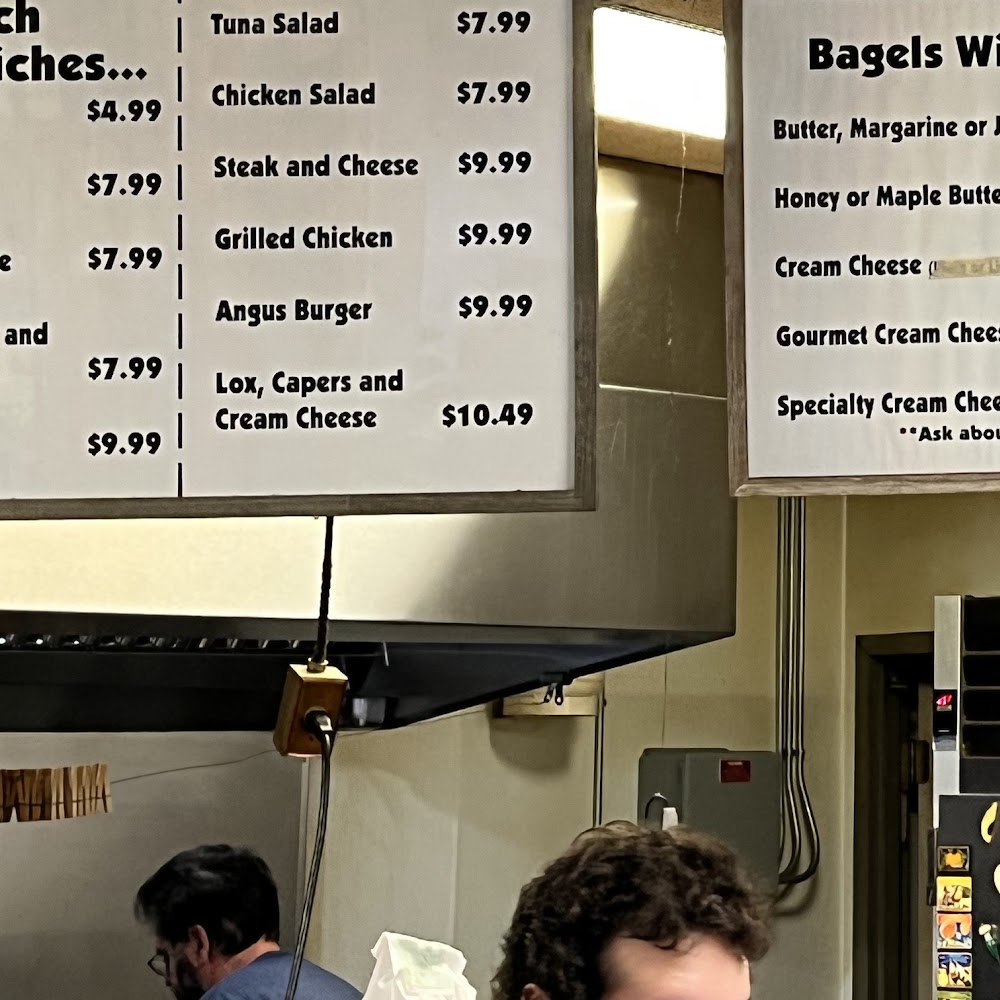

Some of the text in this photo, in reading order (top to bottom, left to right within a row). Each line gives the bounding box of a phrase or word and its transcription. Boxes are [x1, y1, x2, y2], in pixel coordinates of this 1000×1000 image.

[210, 11, 531, 35] Tuna Salad $7.99
[809, 35, 943, 78] Bagels
[212, 81, 531, 107] Chicken Salad $7.99
[87, 99, 162, 122] $4.99
[773, 119, 843, 144] Butter,
[850, 115, 958, 143] Margarine
[965, 120, 988, 137] or
[214, 151, 532, 178] Steak and Cheese $9.99
[87, 172, 162, 196] $7.99
[775, 187, 840, 212] Honey
[846, 190, 870, 207] or
[876, 184, 942, 211] Maple
[215, 222, 532, 250] Grilled Chicken $9.99
[88, 247, 162, 270] $7.99
[775, 256, 841, 278] Cream
[849, 254, 922, 276] Cheese
[215, 294, 533, 327] Angus Burger $9.99
[4, 321, 48, 345] and
[776, 325, 868, 347] Gourmet
[875, 323, 940, 345] Cream
[88, 356, 162, 381] $7.99
[216, 368, 403, 399] Lox, Capers and
[215, 403, 533, 430] Cream Cheese $10.49
[777, 392, 875, 421] Specialty
[881, 392, 947, 414] Cream
[88, 432, 161, 457] $9.99
